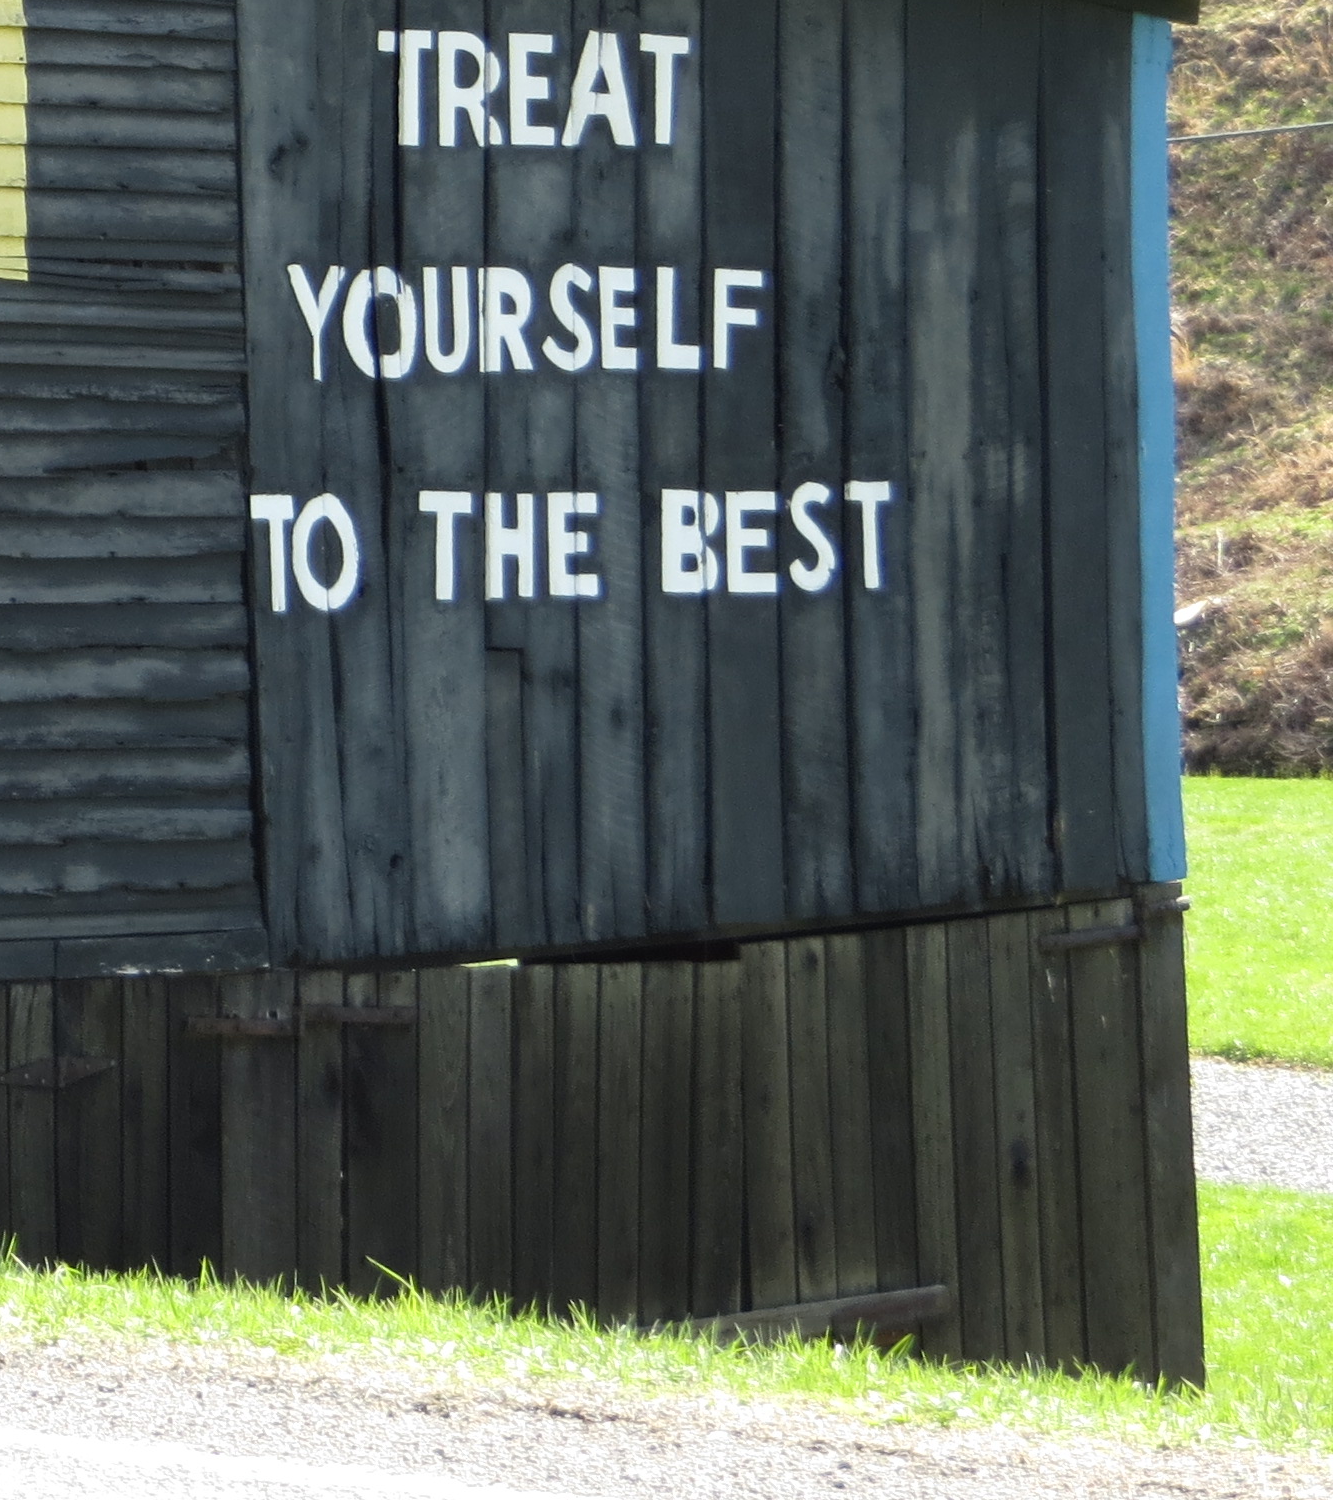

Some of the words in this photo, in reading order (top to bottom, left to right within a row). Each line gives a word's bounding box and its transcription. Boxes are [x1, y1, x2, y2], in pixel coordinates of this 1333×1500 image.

[377, 29, 690, 148] TREAT
[286, 263, 765, 382] YOURSELF
[249, 492, 359, 612] TO
[418, 490, 599, 601] THE
[660, 480, 891, 594] BEST
